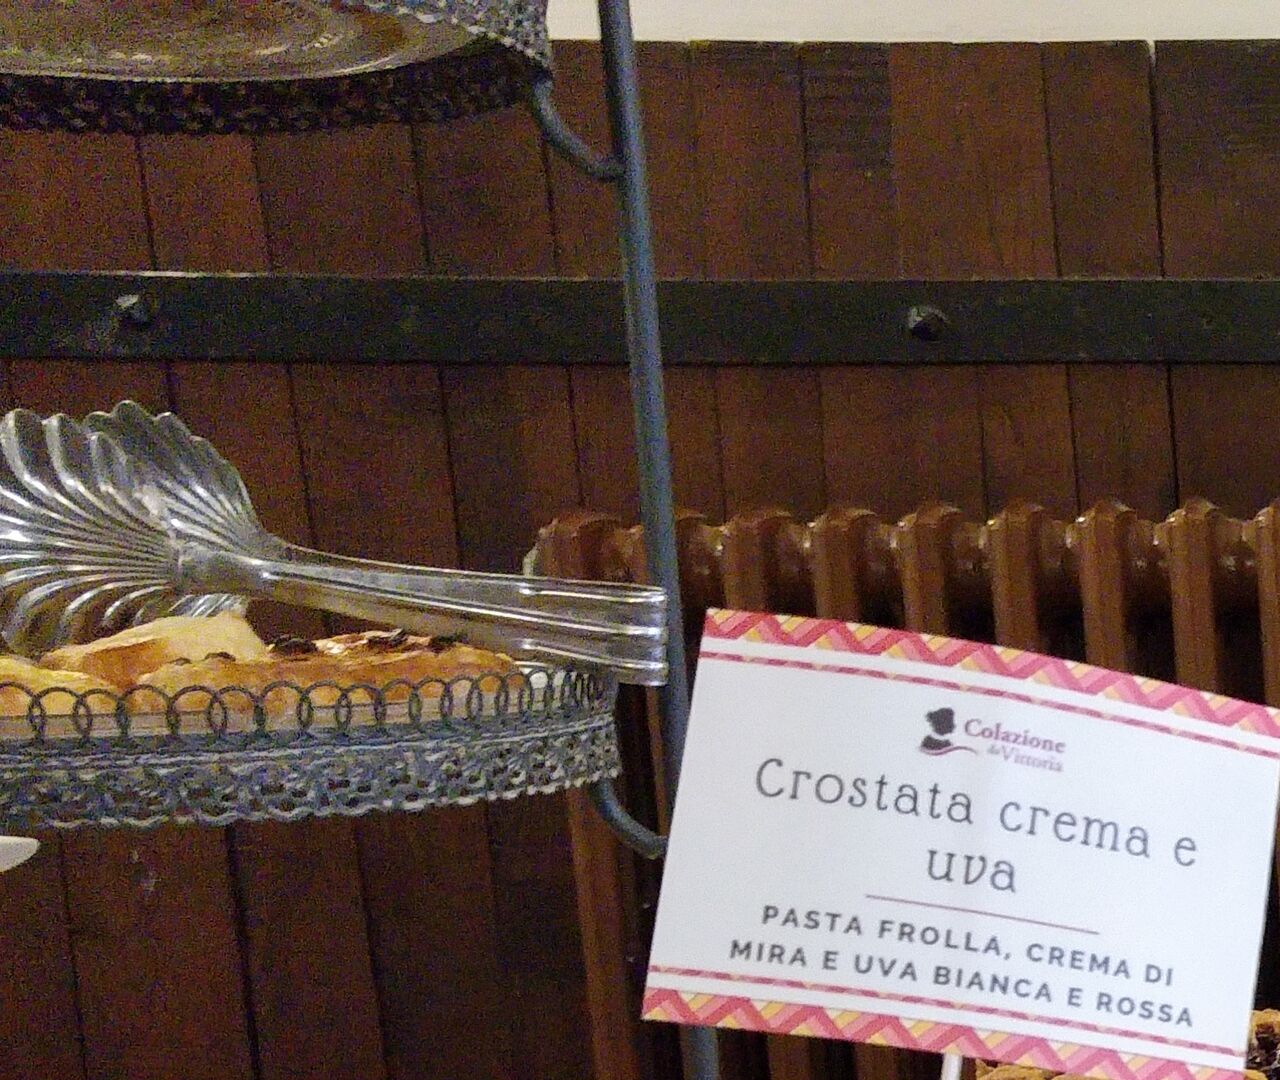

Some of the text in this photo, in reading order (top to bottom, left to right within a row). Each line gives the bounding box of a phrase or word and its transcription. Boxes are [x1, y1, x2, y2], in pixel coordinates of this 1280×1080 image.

[964, 718, 1066, 753] Colazione
[756, 758, 1197, 867] Crostata crema e
[928, 849, 1015, 893] uva
[730, 940, 1192, 1027] MIRA E UVA BIANCA E ROSSA
[762, 905, 1173, 986] PASTA FROLLA, CREMA DI
